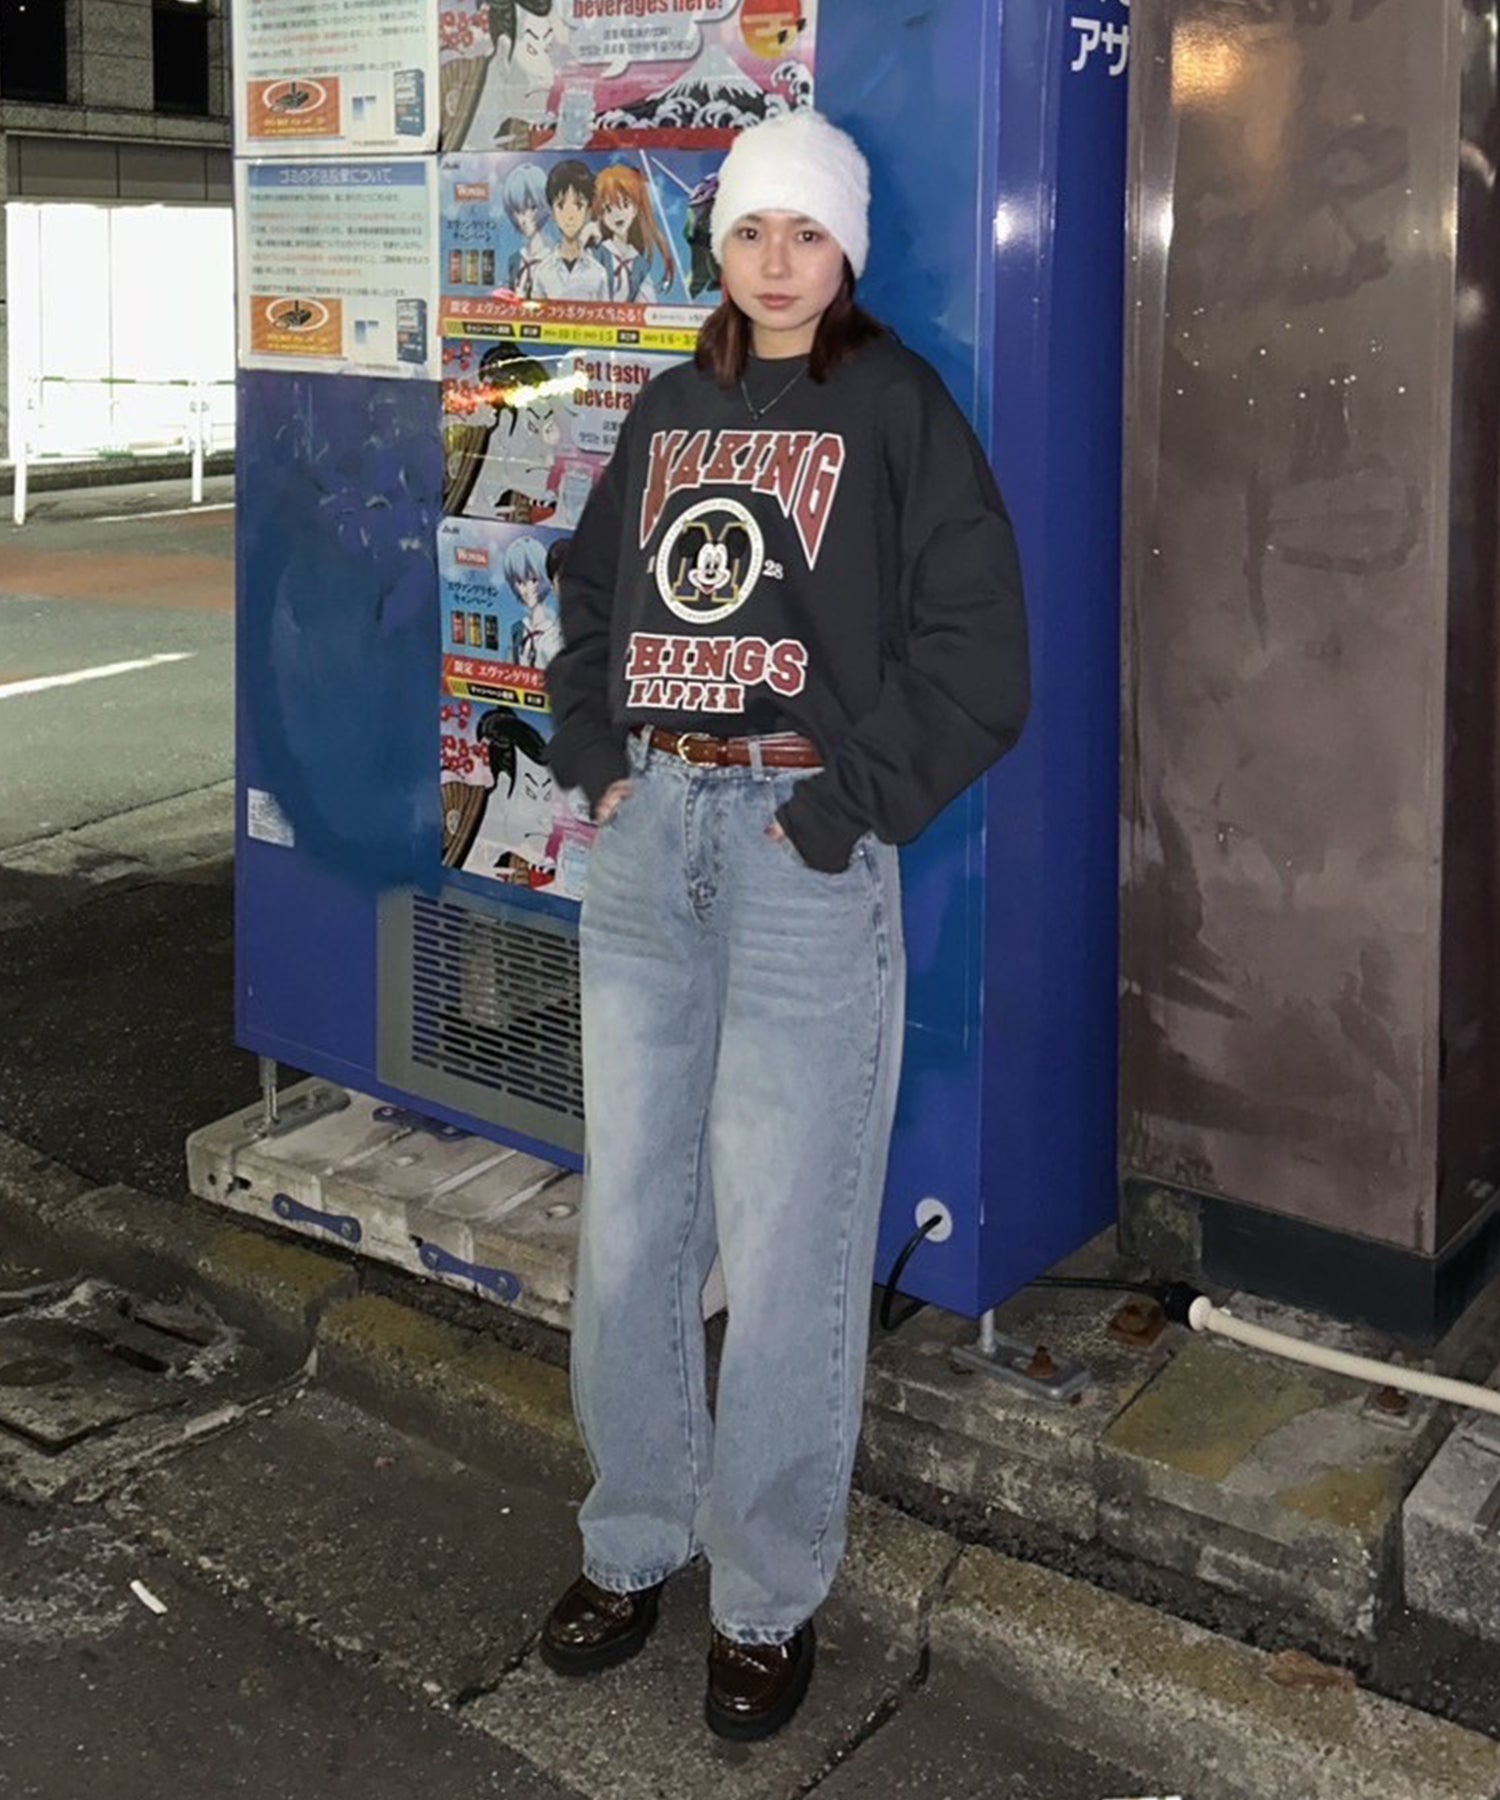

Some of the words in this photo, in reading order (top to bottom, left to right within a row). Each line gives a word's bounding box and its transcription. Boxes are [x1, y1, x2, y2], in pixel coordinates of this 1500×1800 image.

[1071, 17, 1129, 76] アサ
[606, 362, 650, 385] tasty
[574, 388, 640, 411] bevera
[625, 632, 808, 697] HINGS
